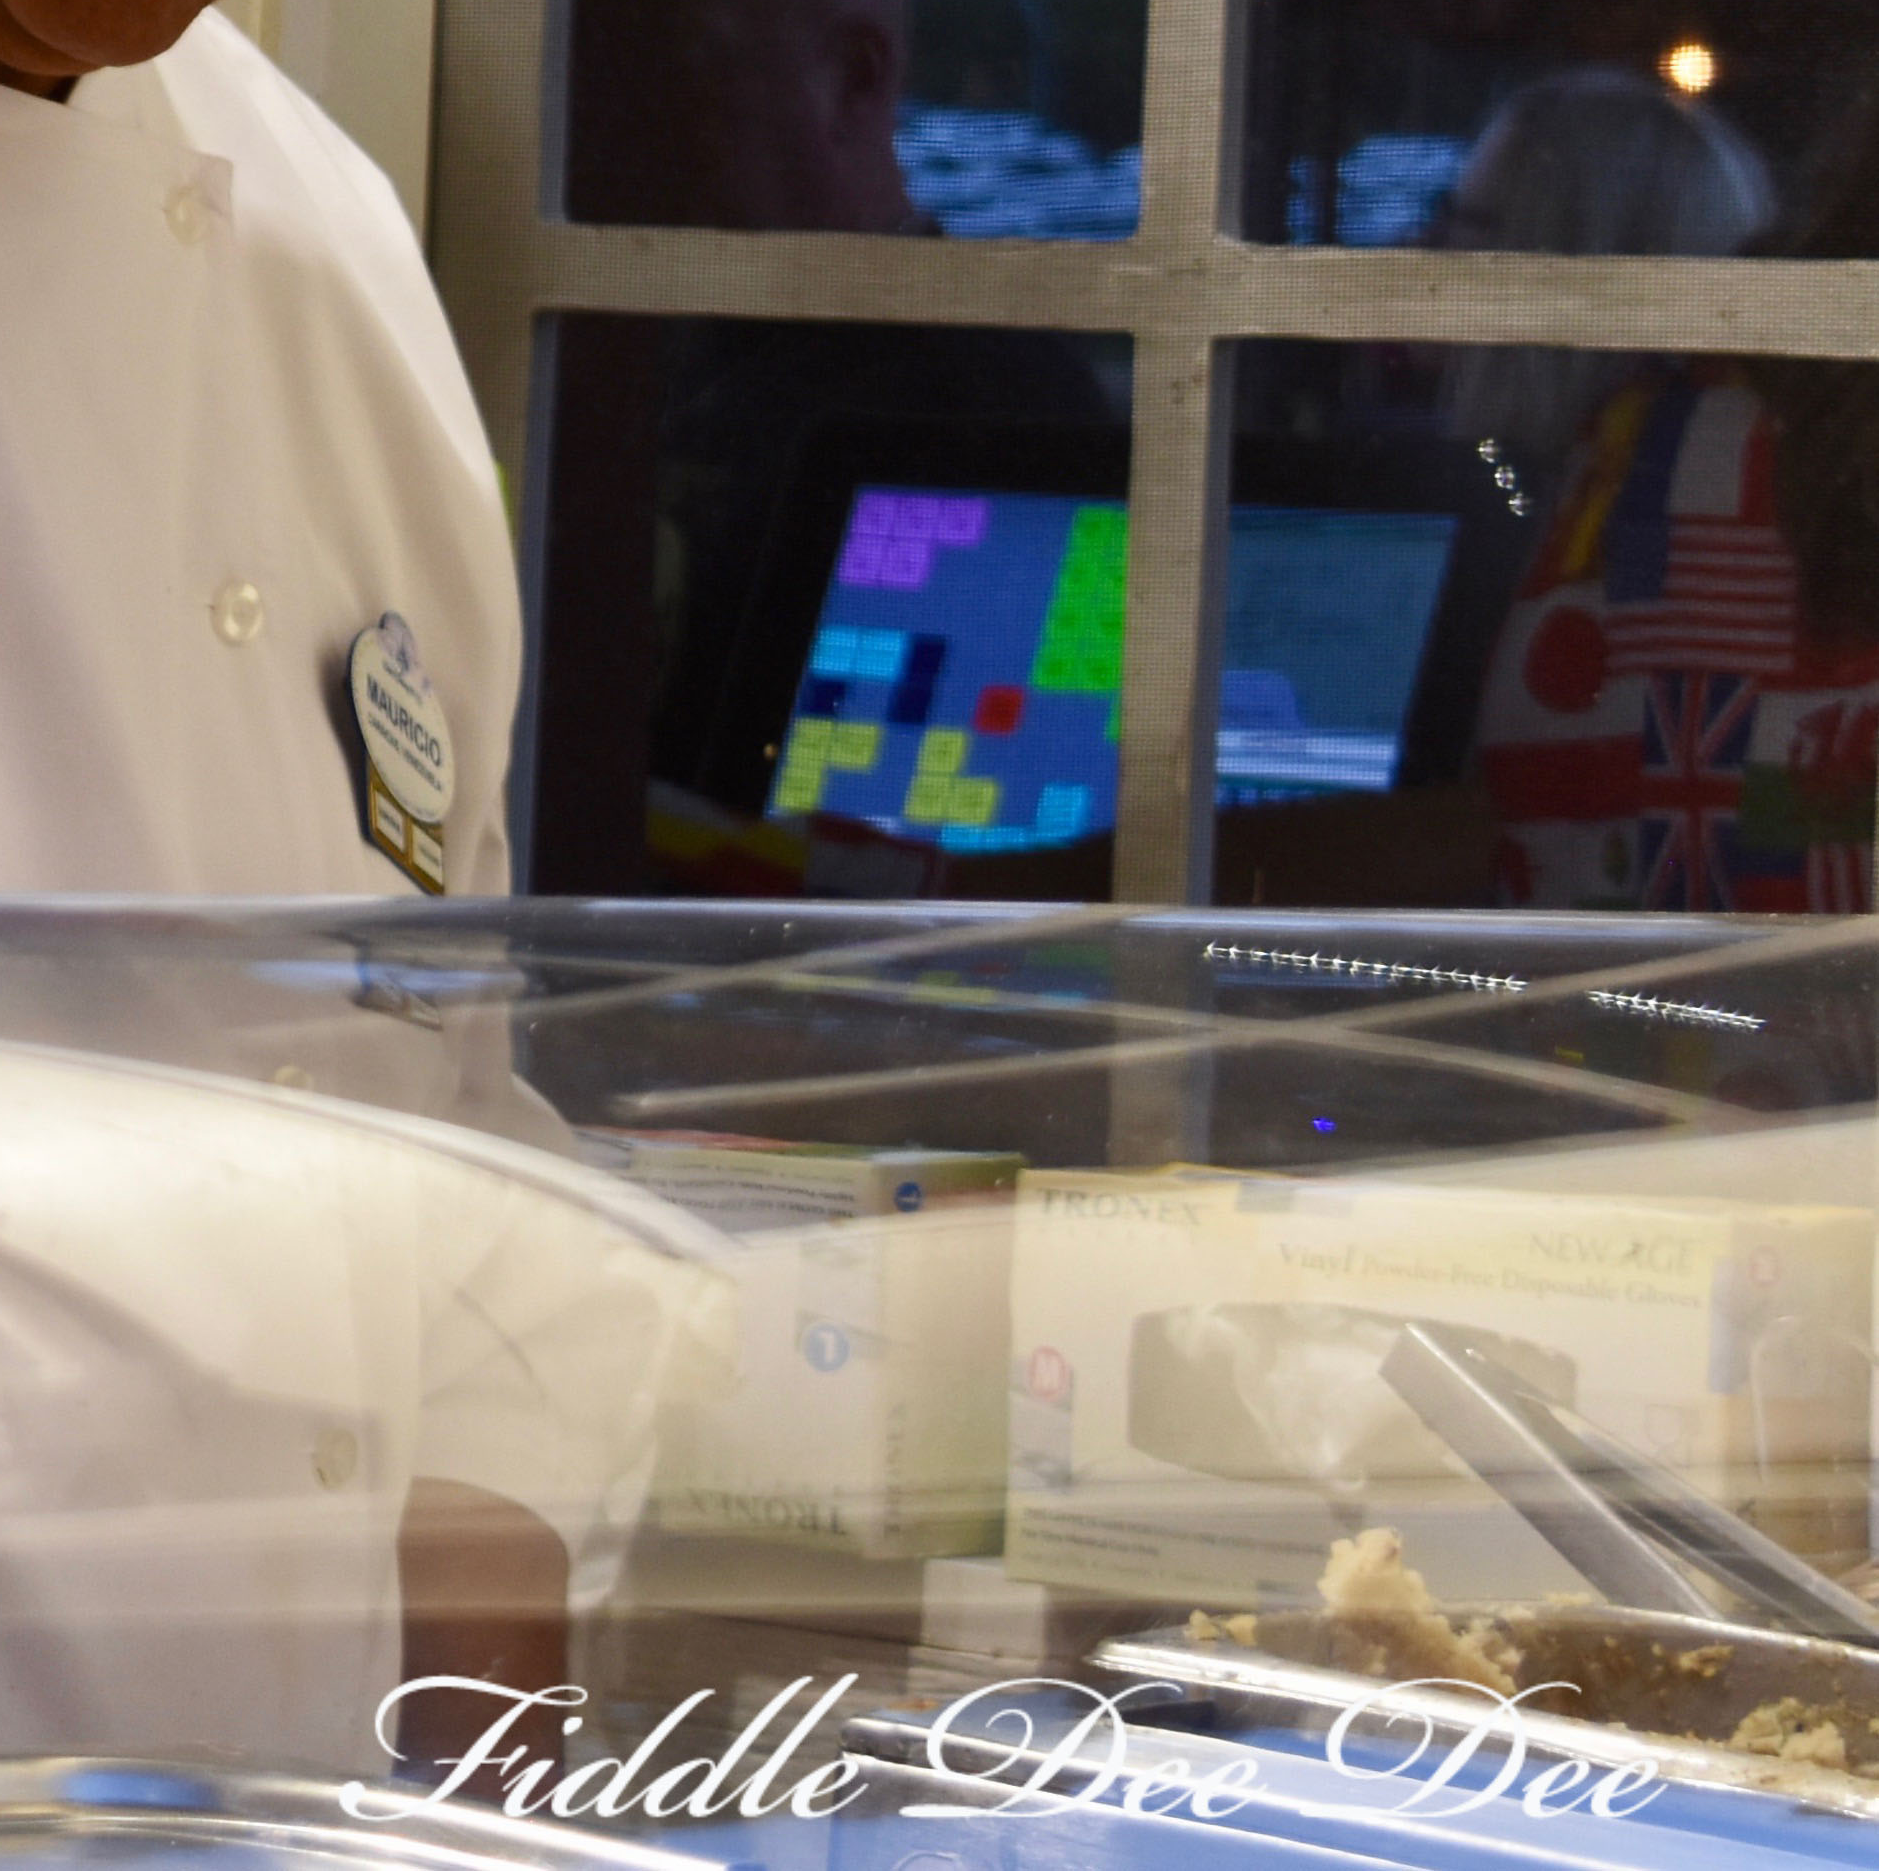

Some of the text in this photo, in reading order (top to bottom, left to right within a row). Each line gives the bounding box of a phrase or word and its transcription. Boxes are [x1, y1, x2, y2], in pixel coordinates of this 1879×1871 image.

[366, 672, 443, 768] MAURICIO
[1037, 1187, 1204, 1227] TRONEX
[1276, 1241, 1702, 1309] Vinyl Powder-Free Disposable Gloves
[1527, 1231, 1699, 1276] NEW AGE
